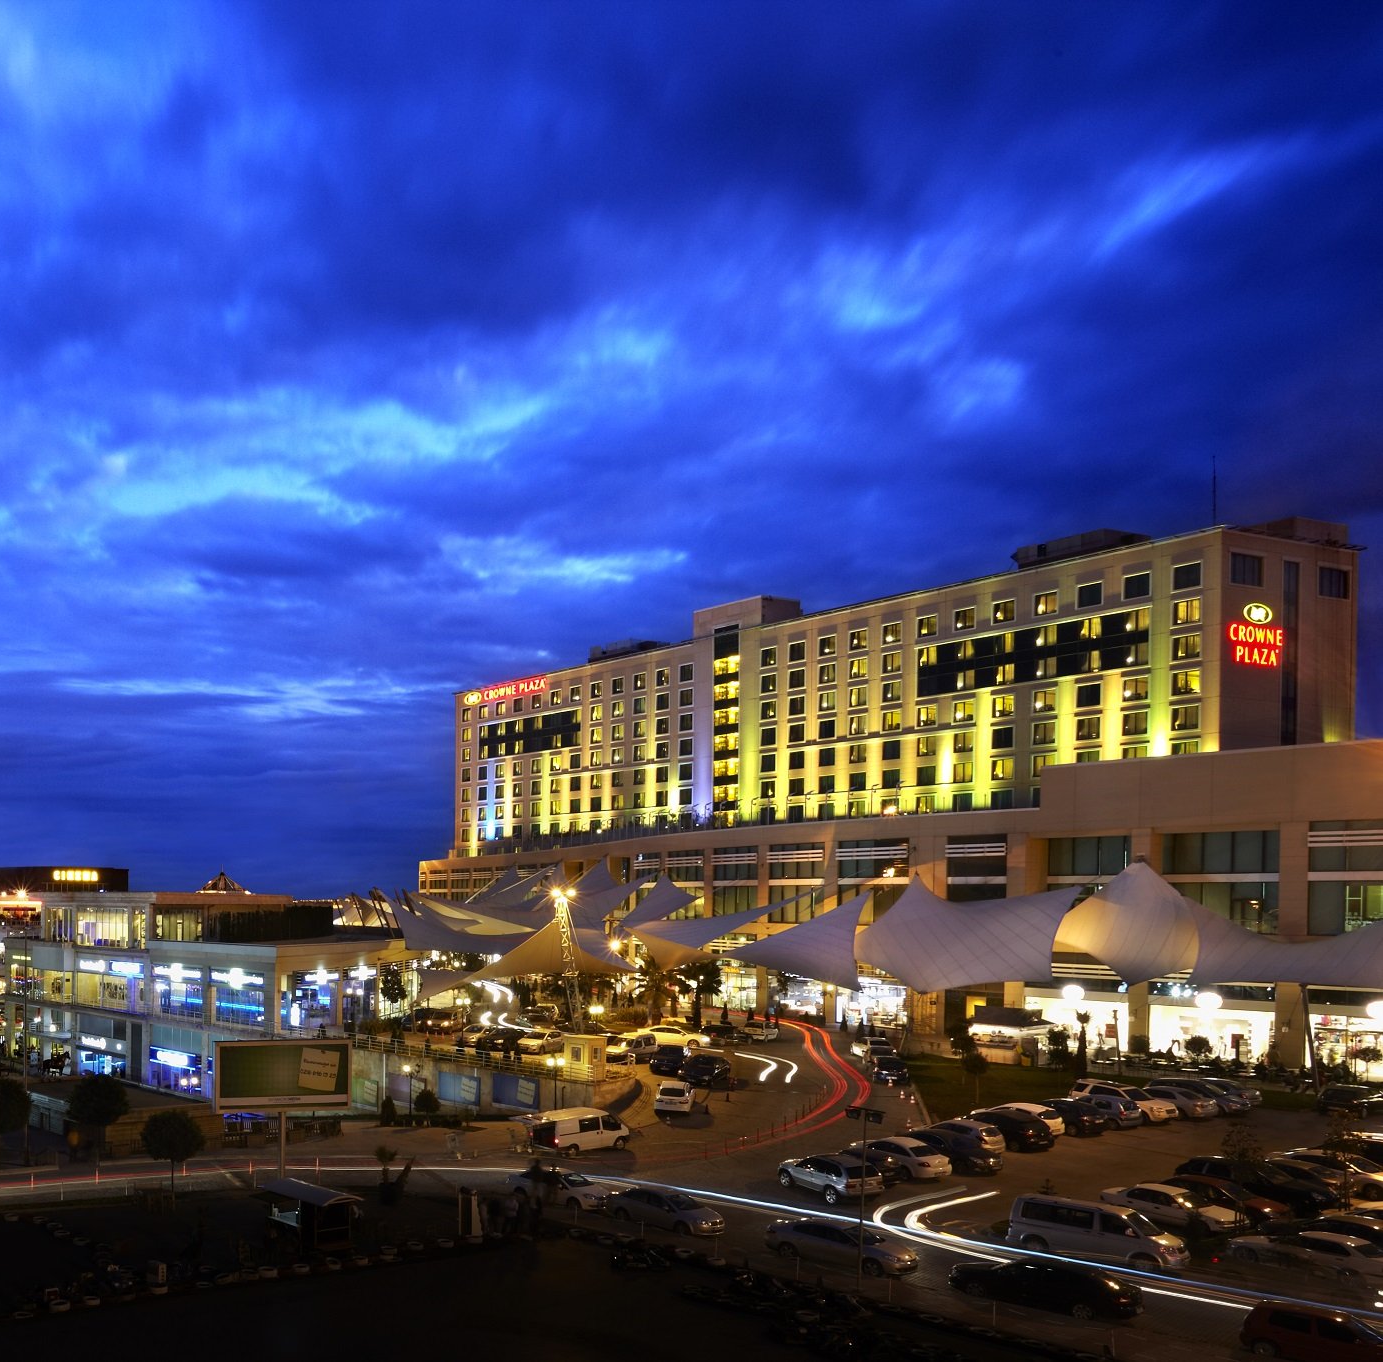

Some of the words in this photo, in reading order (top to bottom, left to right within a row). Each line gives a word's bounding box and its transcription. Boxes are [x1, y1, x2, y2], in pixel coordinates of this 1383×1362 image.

[1229, 623, 1283, 646] CROWNE
[1236, 645, 1278, 667] PLAZA
[483, 684, 517, 701] CROWNE
[519, 678, 547, 693] PLAZA
[53, 869, 99, 882] CINEMA
